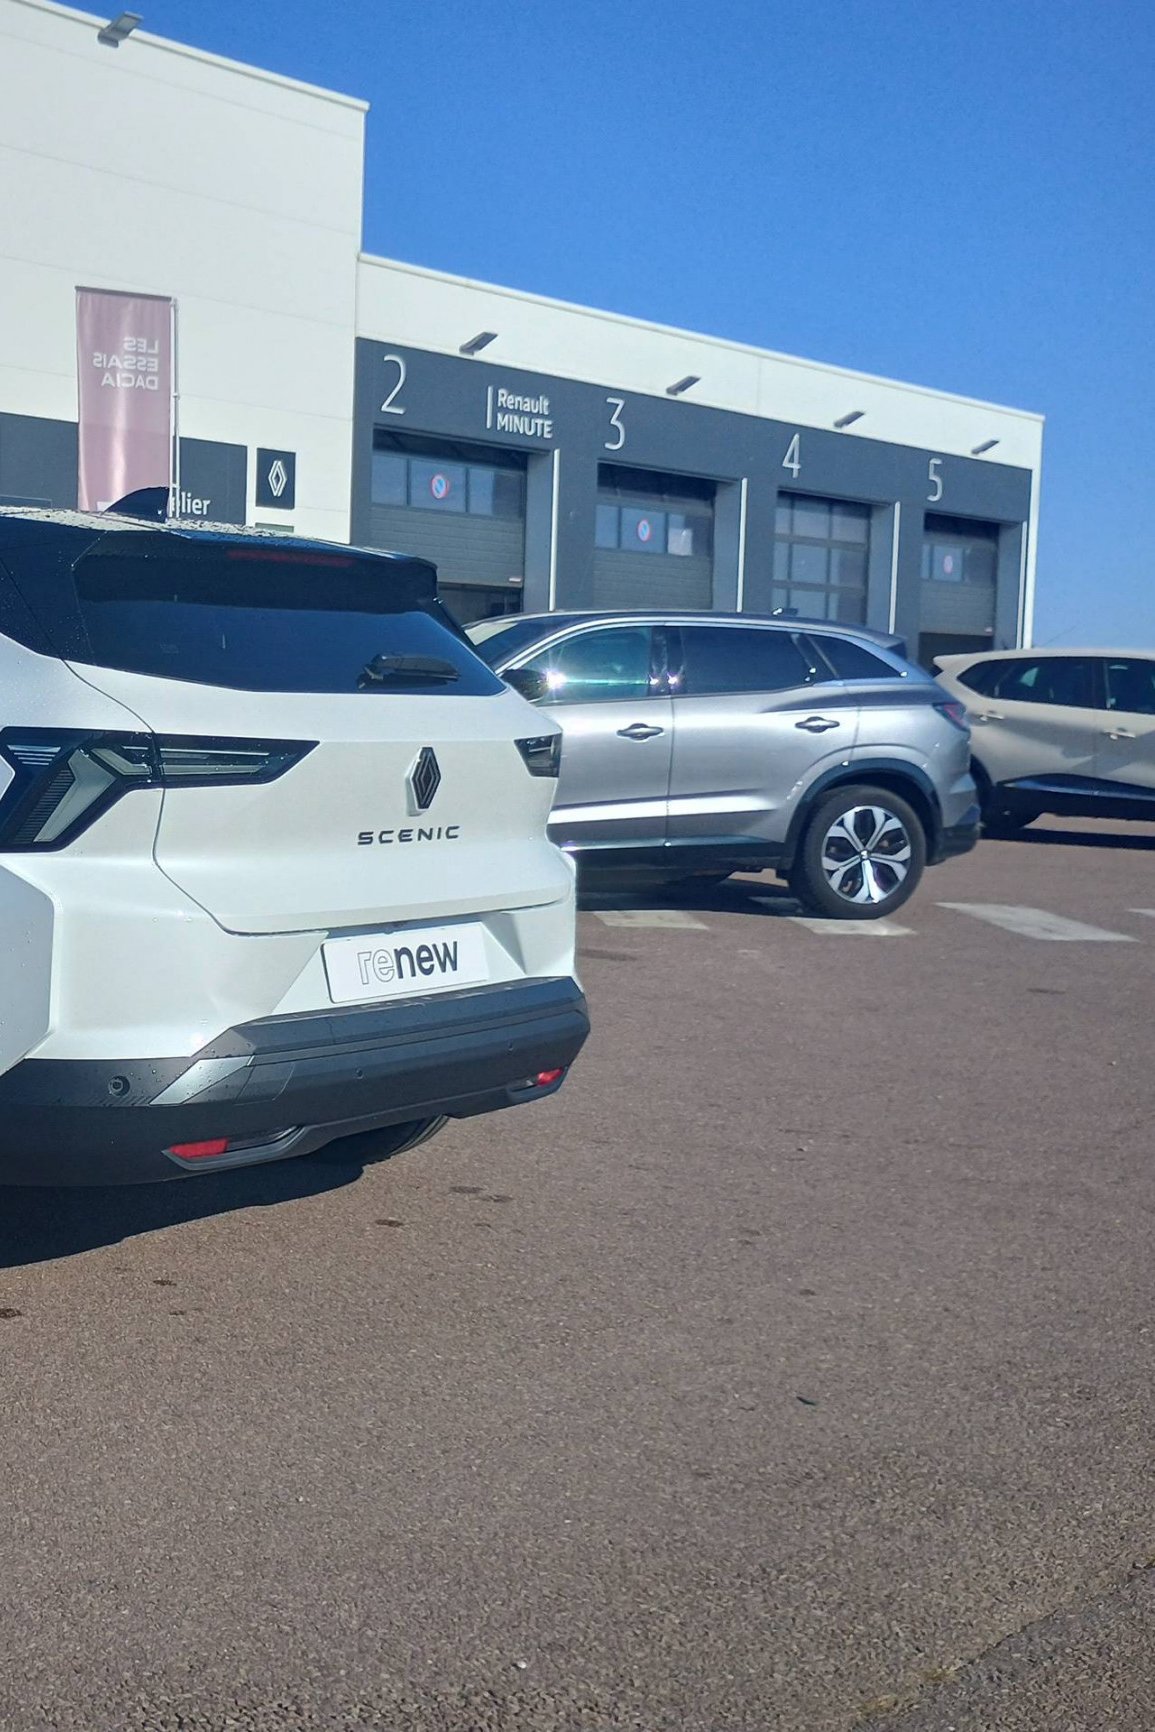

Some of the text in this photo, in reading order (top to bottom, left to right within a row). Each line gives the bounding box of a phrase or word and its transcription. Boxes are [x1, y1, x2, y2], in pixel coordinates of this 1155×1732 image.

[380, 354, 406, 415] 2
[497, 388, 550, 415] Renault
[497, 412, 553, 439] MINUTE
[604, 397, 626, 451] 3
[782, 433, 801, 478] 4
[927, 457, 943, 502] 5
[357, 825, 461, 845] SCENIC
[357, 941, 458, 985] renew
